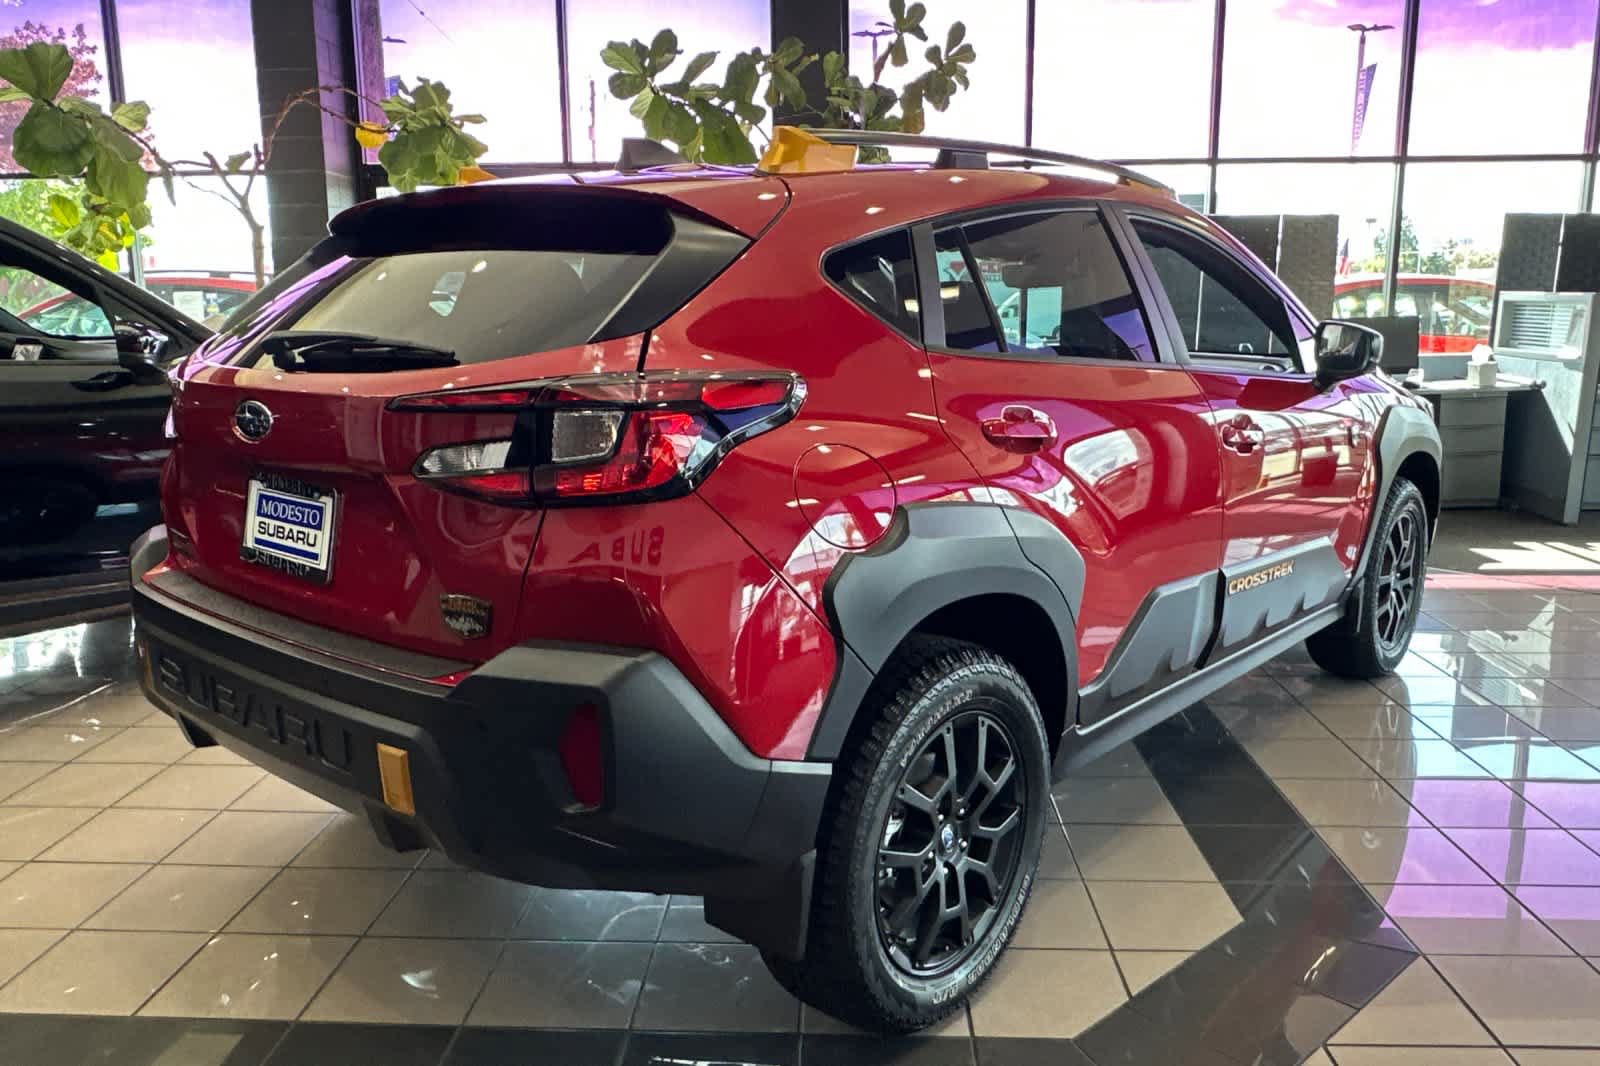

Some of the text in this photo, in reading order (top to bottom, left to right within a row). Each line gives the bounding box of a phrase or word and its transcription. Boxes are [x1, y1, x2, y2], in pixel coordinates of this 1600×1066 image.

[260, 499, 321, 526] MODESTO
[257, 521, 317, 547] SUBARU
[1227, 559, 1295, 596] CROSSTREK
[159, 655, 353, 777] SUBARU
